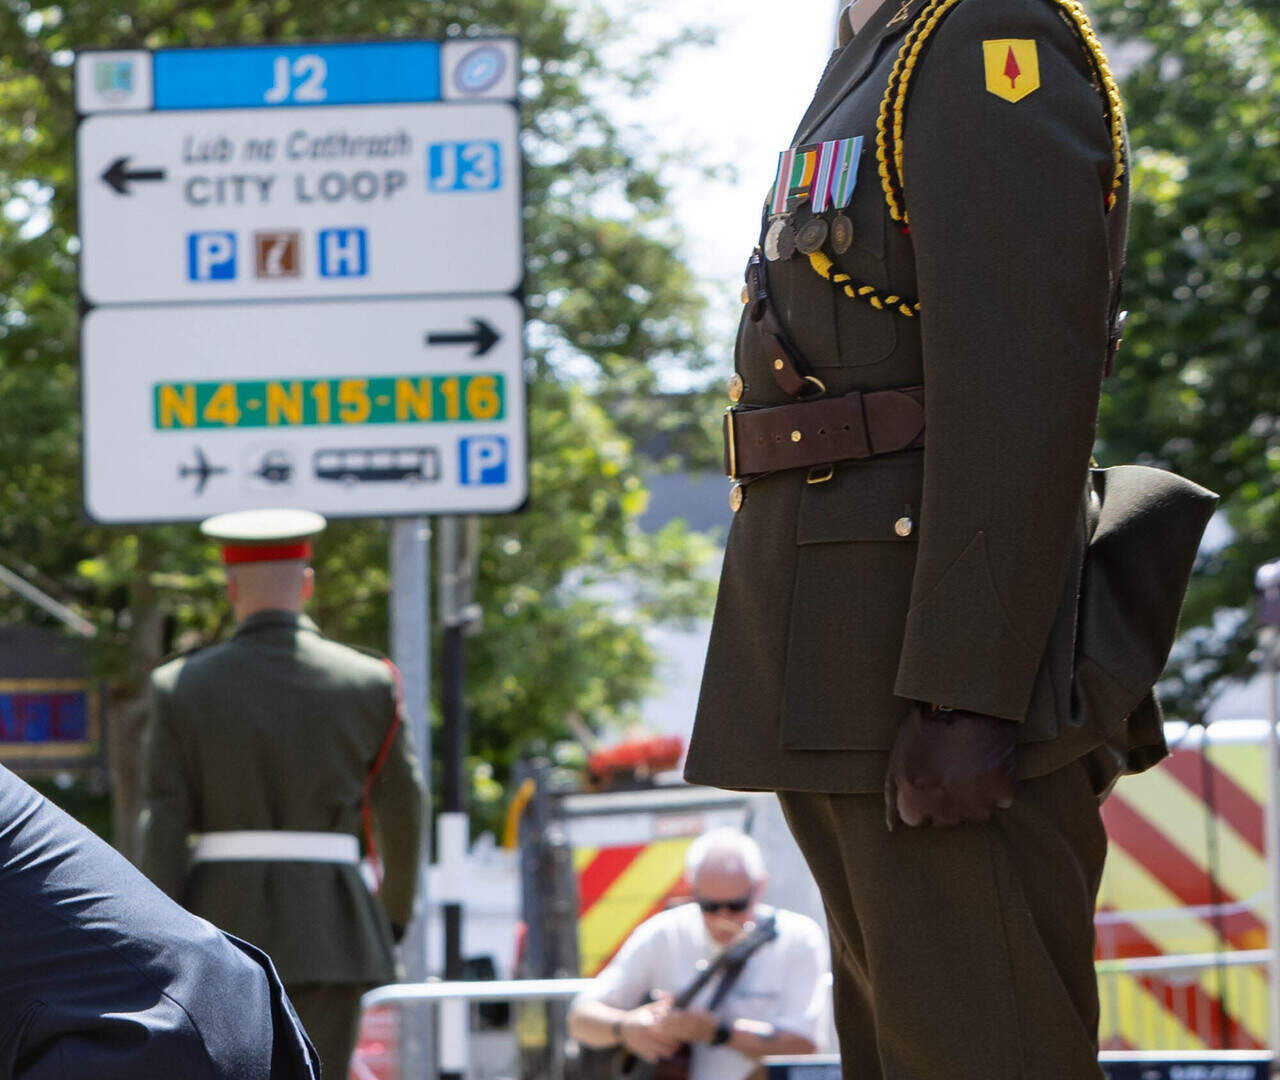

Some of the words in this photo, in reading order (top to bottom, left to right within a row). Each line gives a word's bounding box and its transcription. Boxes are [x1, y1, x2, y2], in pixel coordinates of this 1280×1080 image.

[264, 53, 328, 104] J2
[185, 174, 275, 206] CITY
[295, 168, 408, 204] LOOP
[433, 143, 500, 189] J3
[196, 233, 233, 279] P
[326, 231, 361, 277] H
[467, 437, 505, 485] P
